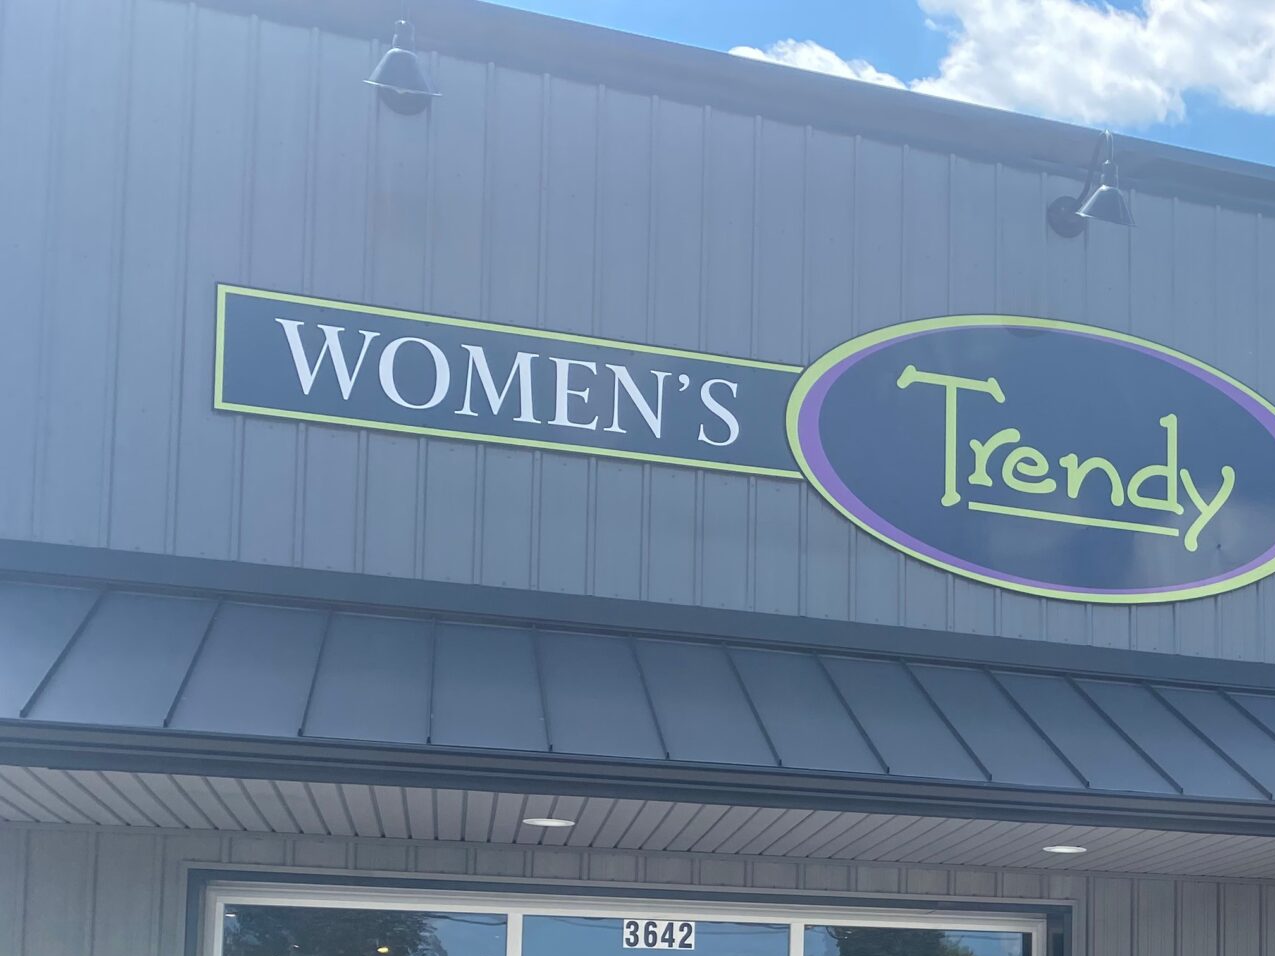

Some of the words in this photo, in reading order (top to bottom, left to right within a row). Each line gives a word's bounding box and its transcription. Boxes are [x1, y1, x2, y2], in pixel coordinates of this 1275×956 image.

[275, 318, 739, 446] WOMEN'S
[897, 365, 1235, 551] Trendy
[625, 920, 693, 949] 3642
